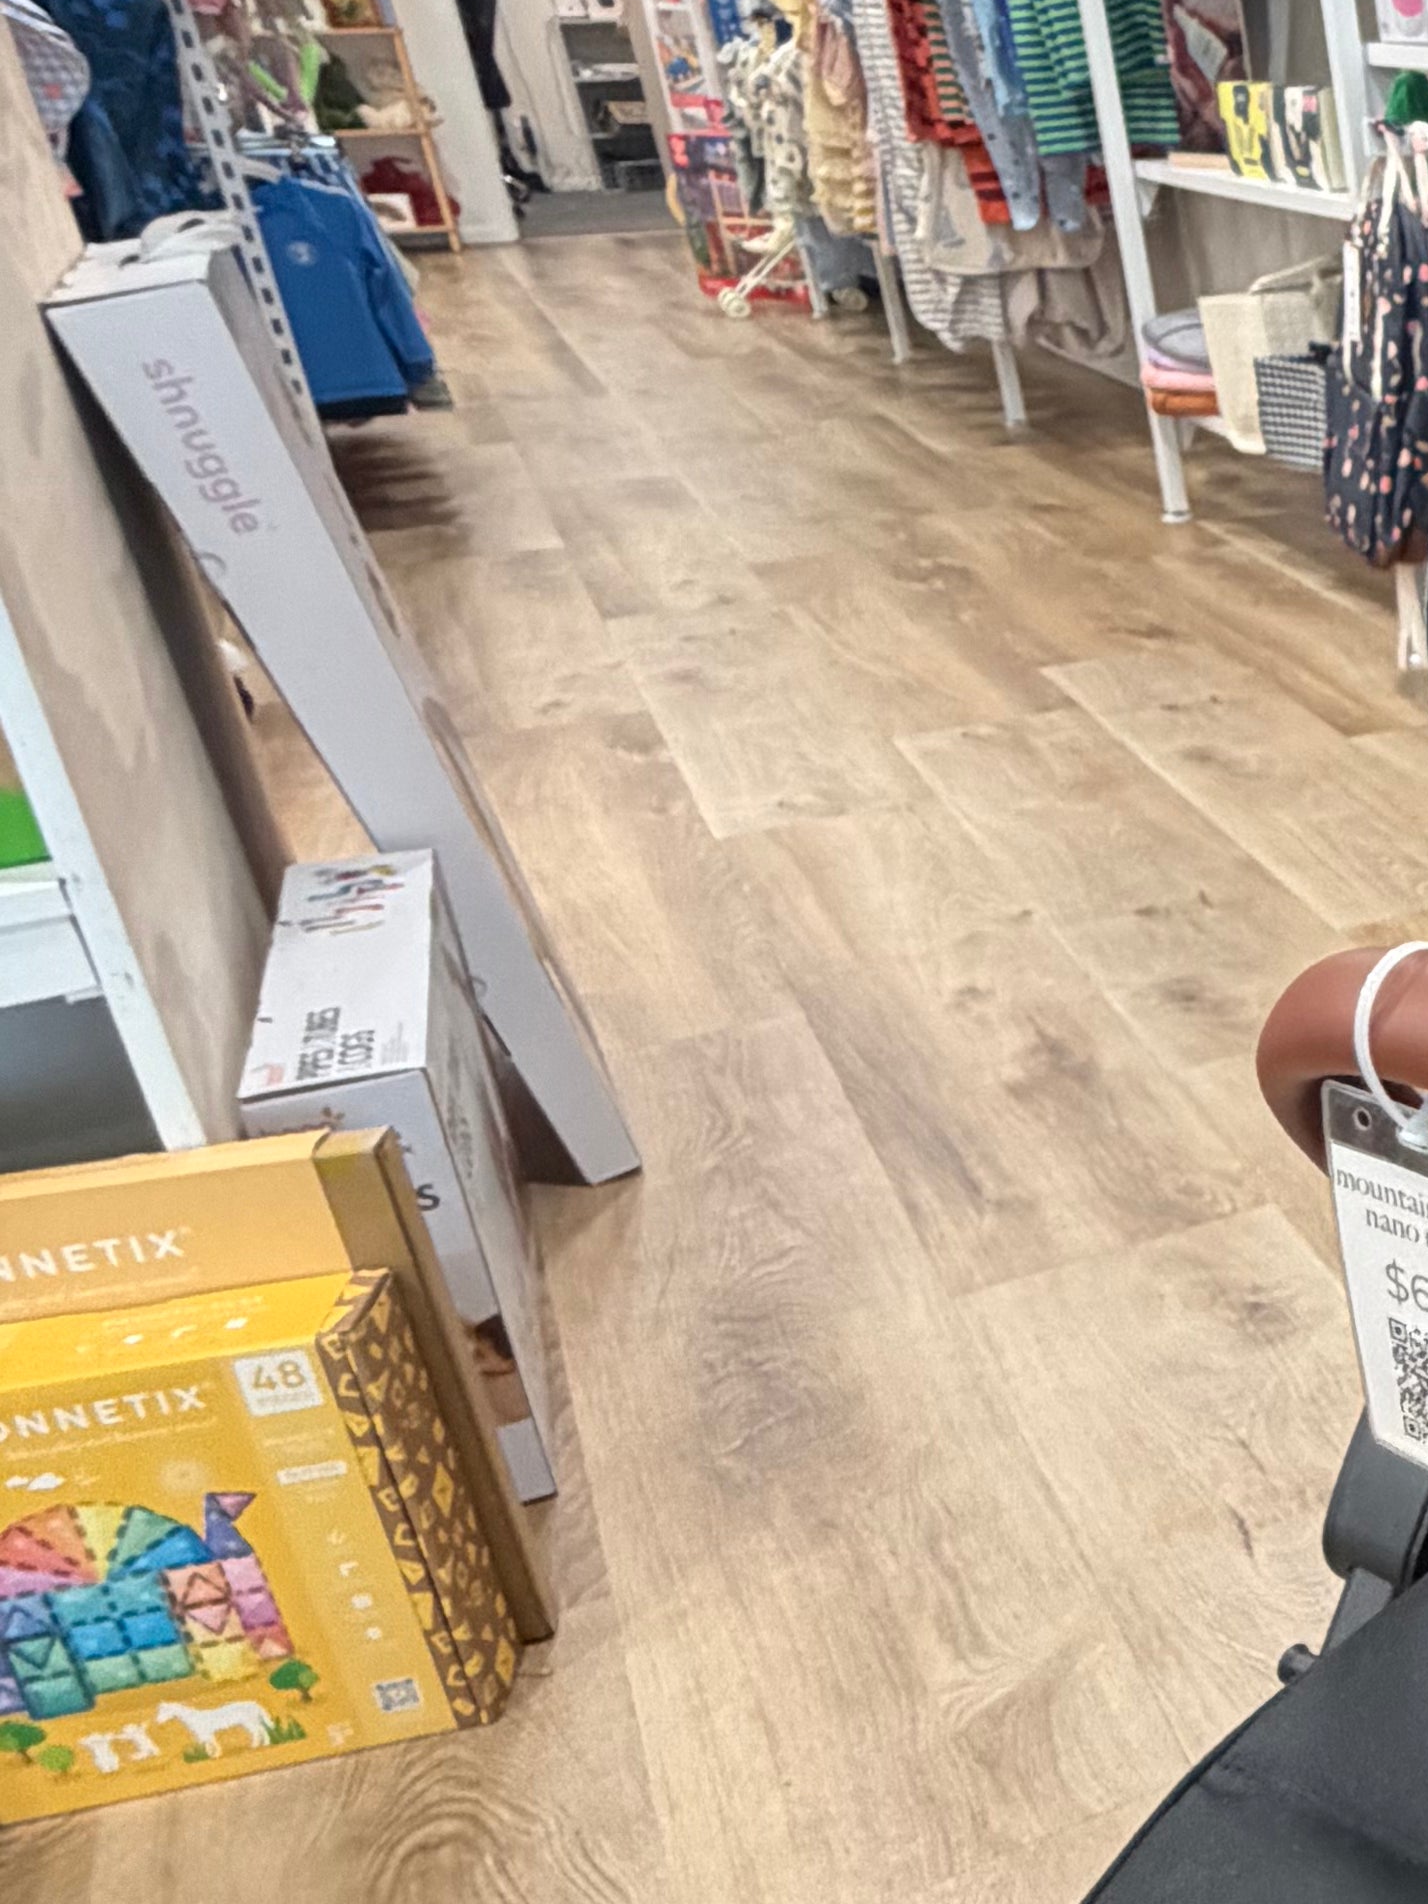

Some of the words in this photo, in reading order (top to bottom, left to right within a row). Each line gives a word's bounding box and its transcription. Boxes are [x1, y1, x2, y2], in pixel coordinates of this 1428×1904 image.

[142, 358, 261, 535] shnuggle
[1365, 1208, 1420, 1243] nano
[253, 1359, 307, 1391] 48
